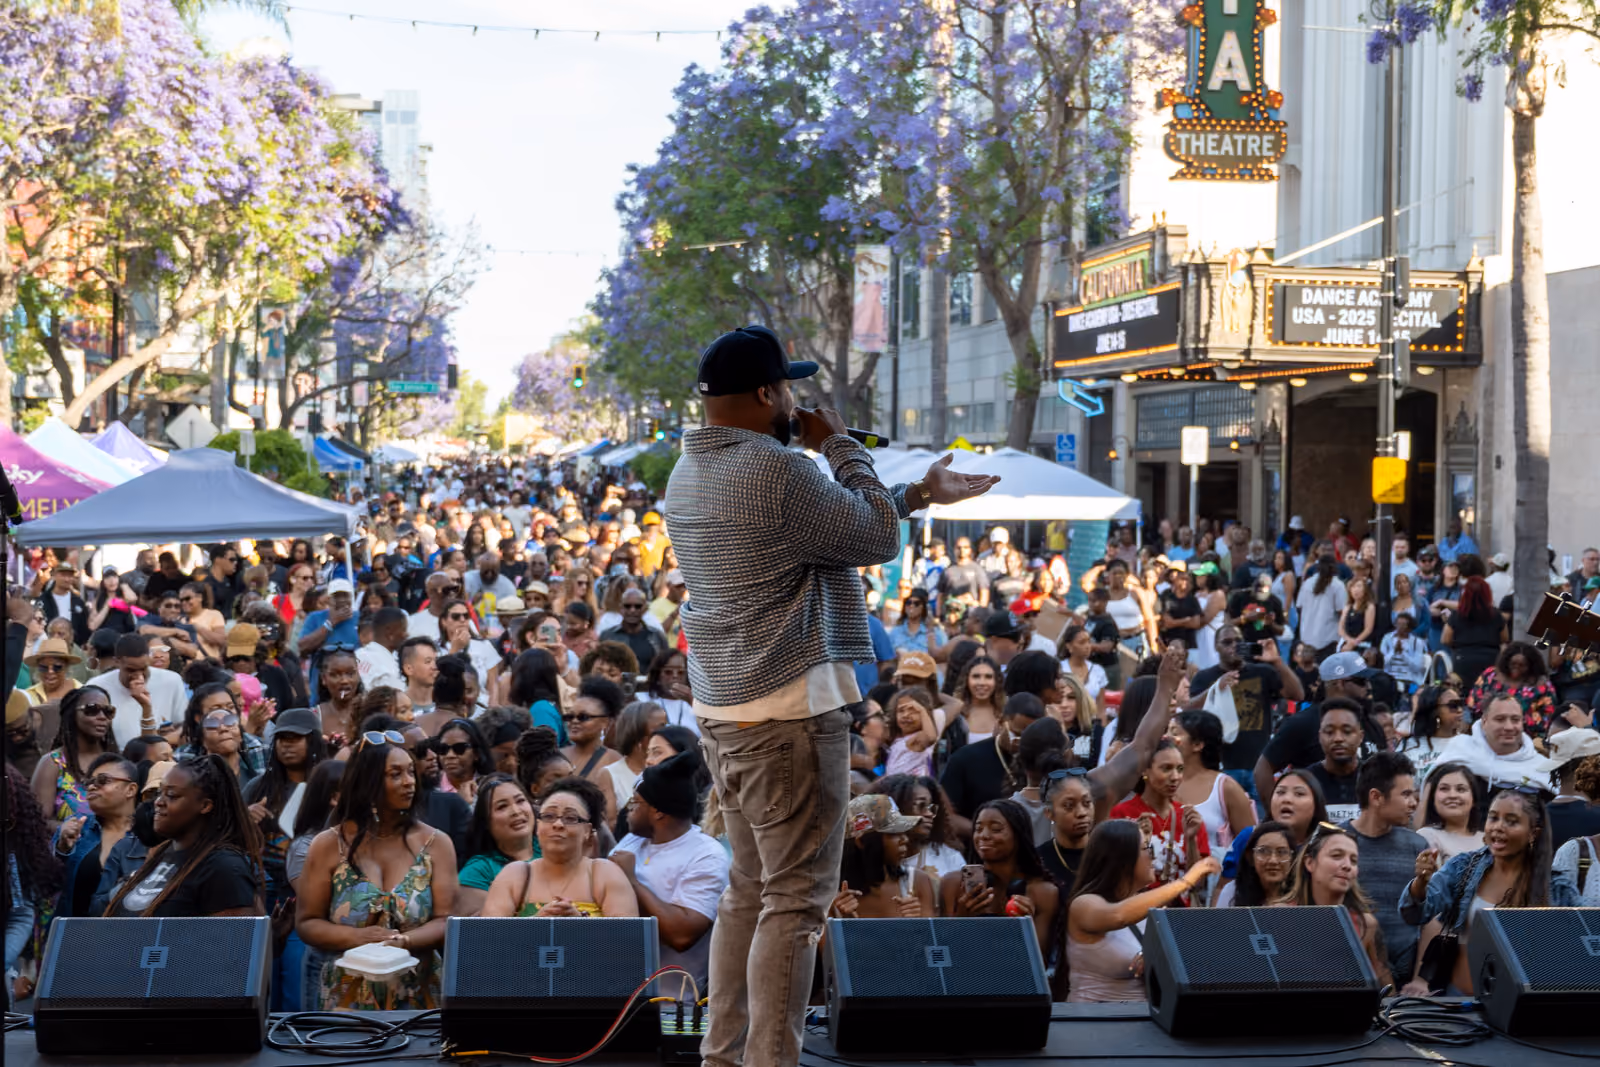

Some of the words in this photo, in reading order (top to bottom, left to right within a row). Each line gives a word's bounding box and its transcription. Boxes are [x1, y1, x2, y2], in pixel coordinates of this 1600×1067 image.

[1176, 133, 1275, 157] THEATRE
[1302, 287, 1355, 306] DANCE
[1356, 289, 1433, 308] ACMY
[1292, 307, 1325, 325] USA
[1338, 308, 1376, 326] 2025
[1390, 310, 1442, 328] CITAL
[1322, 327, 1364, 344] JUNE
